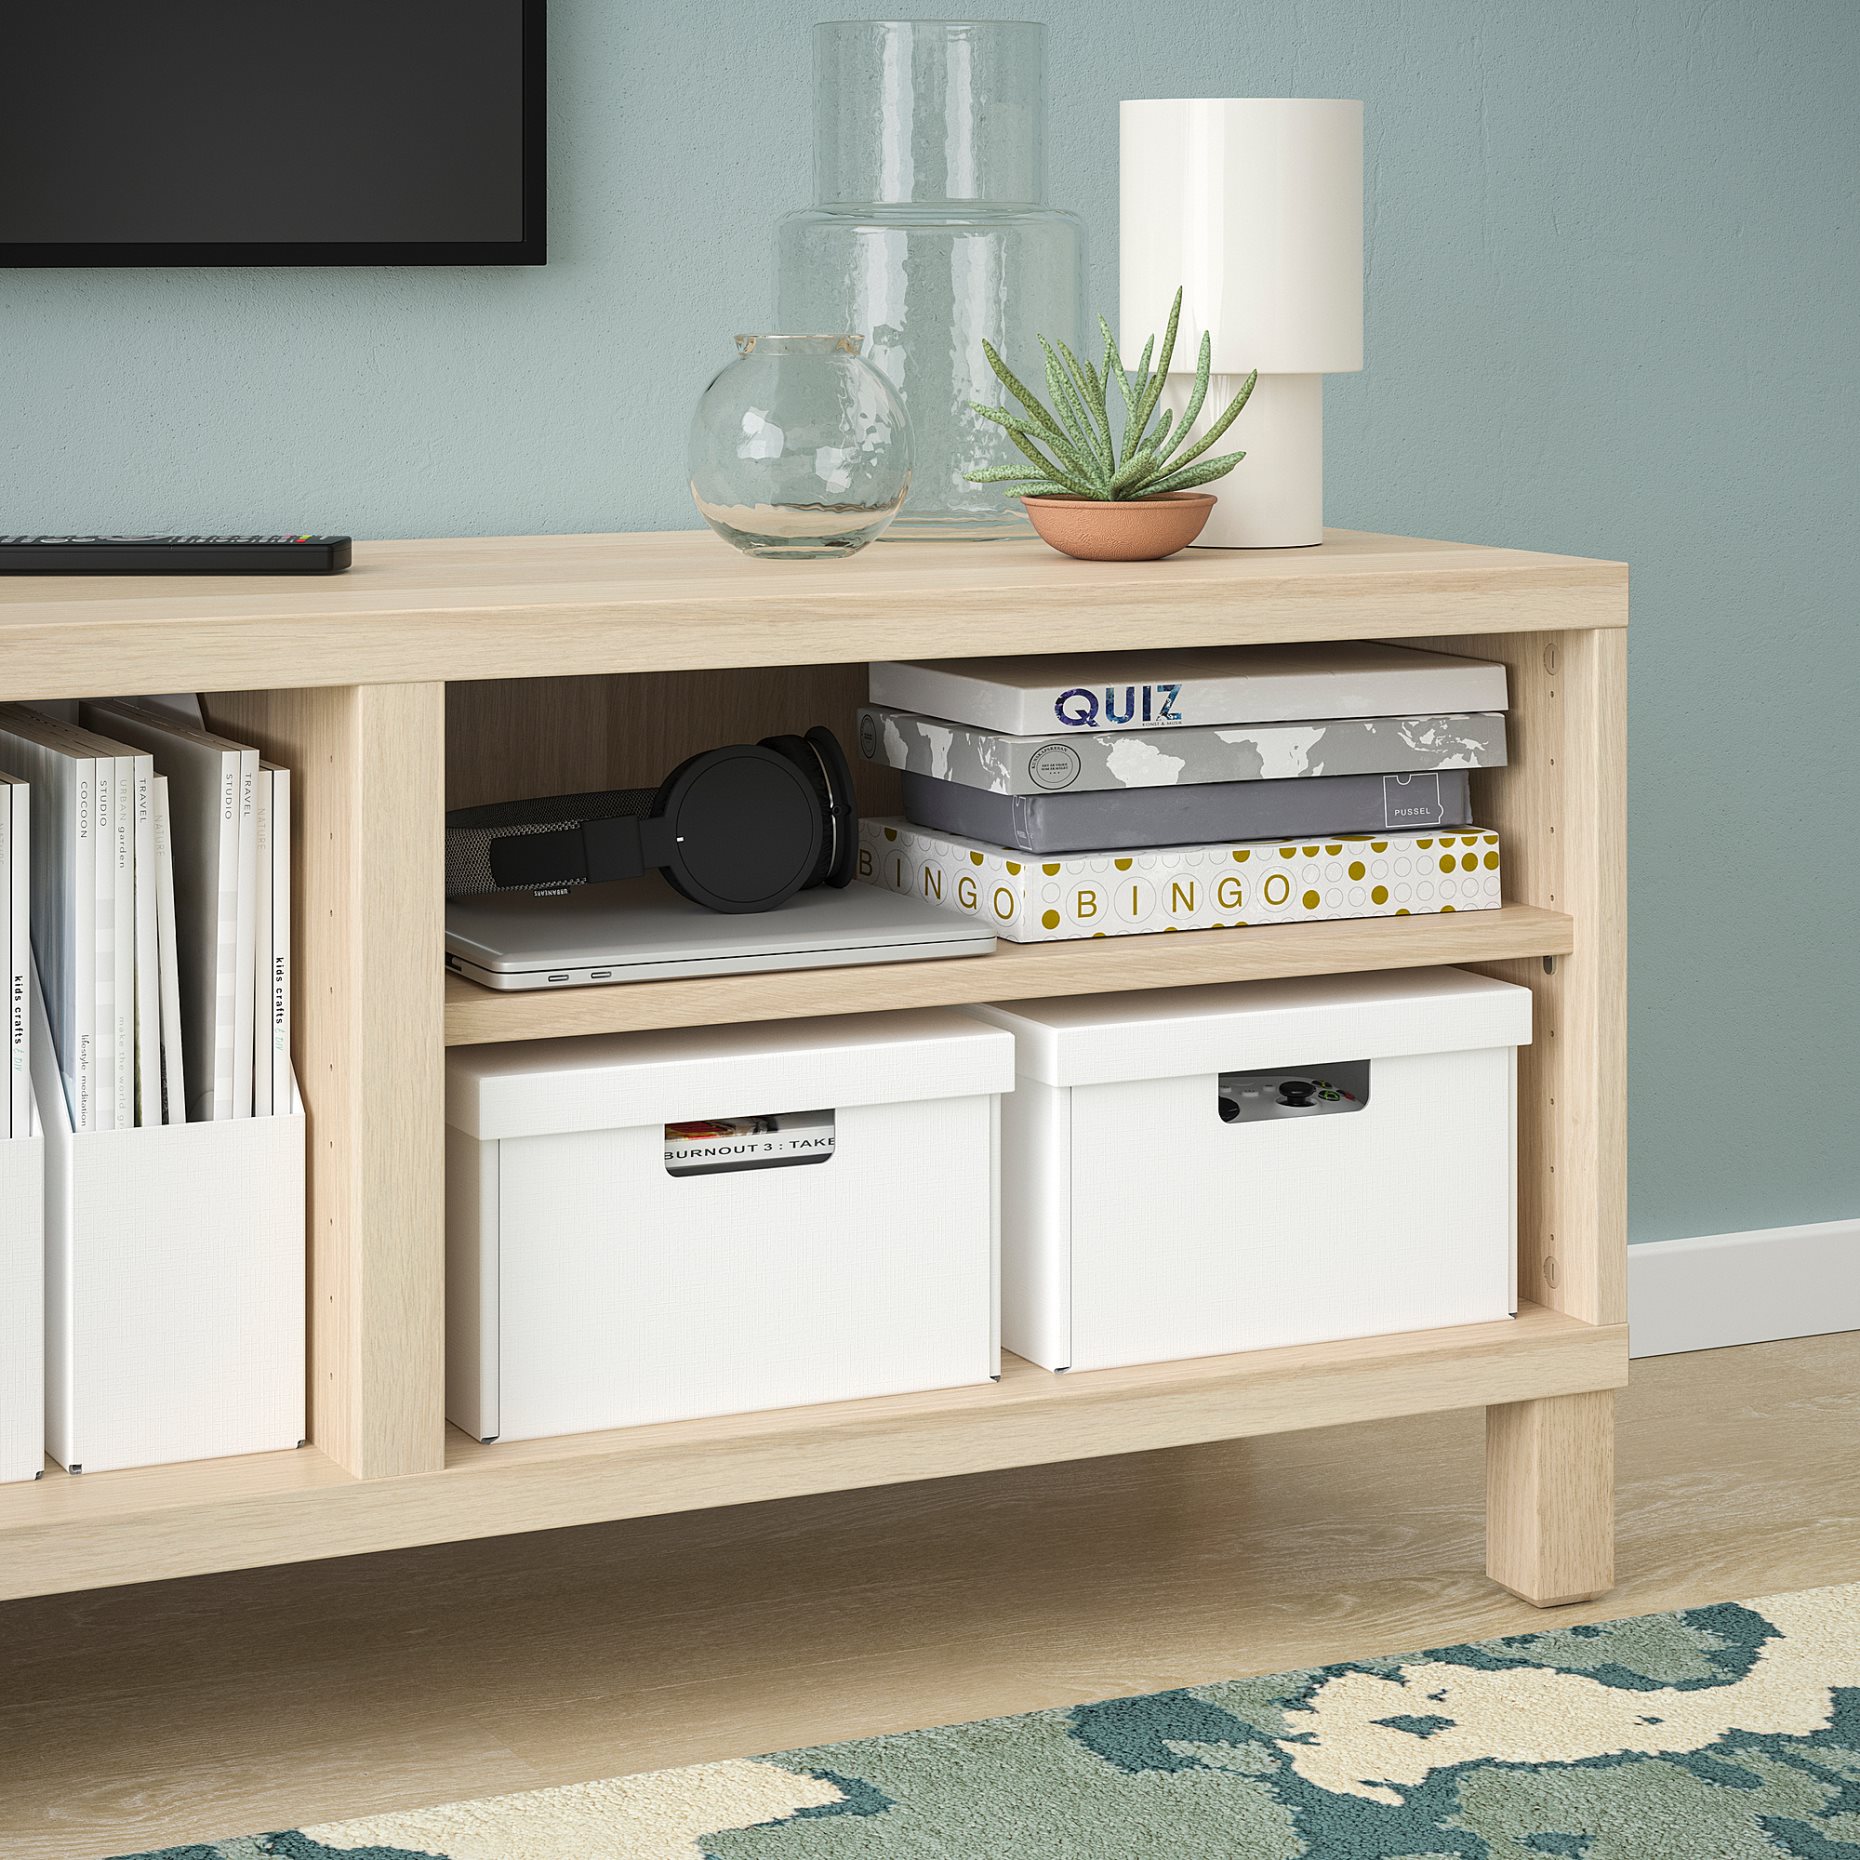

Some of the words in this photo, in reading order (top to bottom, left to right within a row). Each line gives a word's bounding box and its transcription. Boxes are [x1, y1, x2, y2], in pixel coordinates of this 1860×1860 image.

[1054, 684, 1182, 727] QUIZ
[80, 781, 88, 838] COCOON
[99, 780, 108, 827] STUDIO
[119, 779, 127, 821] URBAN
[138, 778, 148, 823] TRAVEL
[224, 773, 233, 820] STUDIO
[243, 772, 252, 817] TRAVEL
[1394, 807, 1431, 816] PUSSEL
[118, 826, 127, 869] garden
[153, 814, 165, 857] NATURE
[859, 849, 1014, 920] BINGO
[1077, 873, 1290, 918] BINGO
[14, 975, 23, 1002] kids
[275, 957, 284, 982] kids
[14, 1006, 23, 1045] crafts
[275, 987, 285, 1024] crafts
[79, 1034, 90, 1071] lifestyle
[118, 1076, 126, 1109] world
[665, 1144, 758, 1160] BURNOUT
[763, 1143, 773, 1151] 3
[789, 1137, 835, 1149] TAKE
